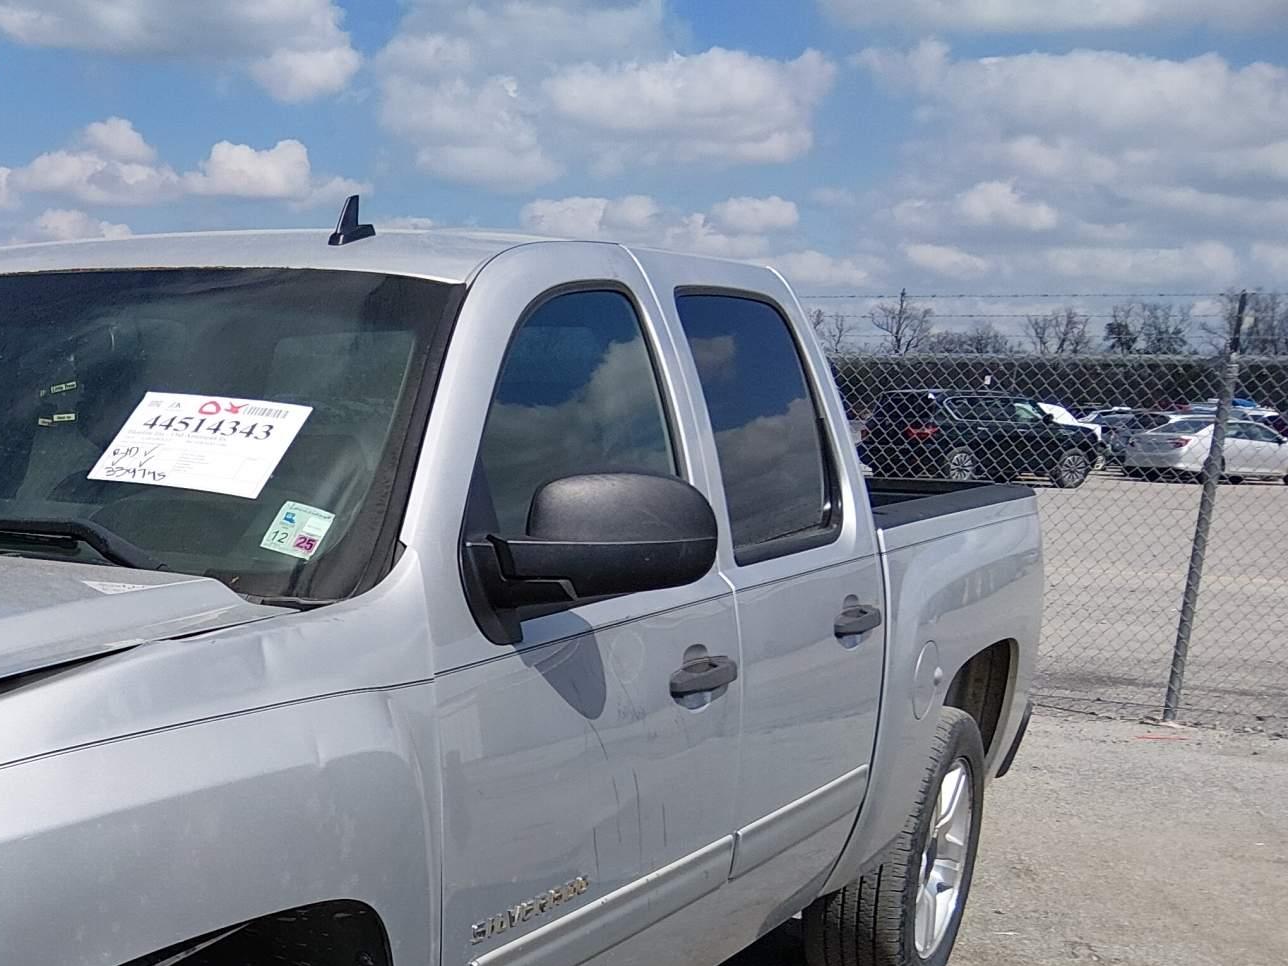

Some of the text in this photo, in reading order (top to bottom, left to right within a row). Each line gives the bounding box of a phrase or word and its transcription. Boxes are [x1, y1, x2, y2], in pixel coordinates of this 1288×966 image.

[143, 414, 274, 440] 44514343
[271, 530, 289, 544] 12
[296, 536, 315, 551] 25
